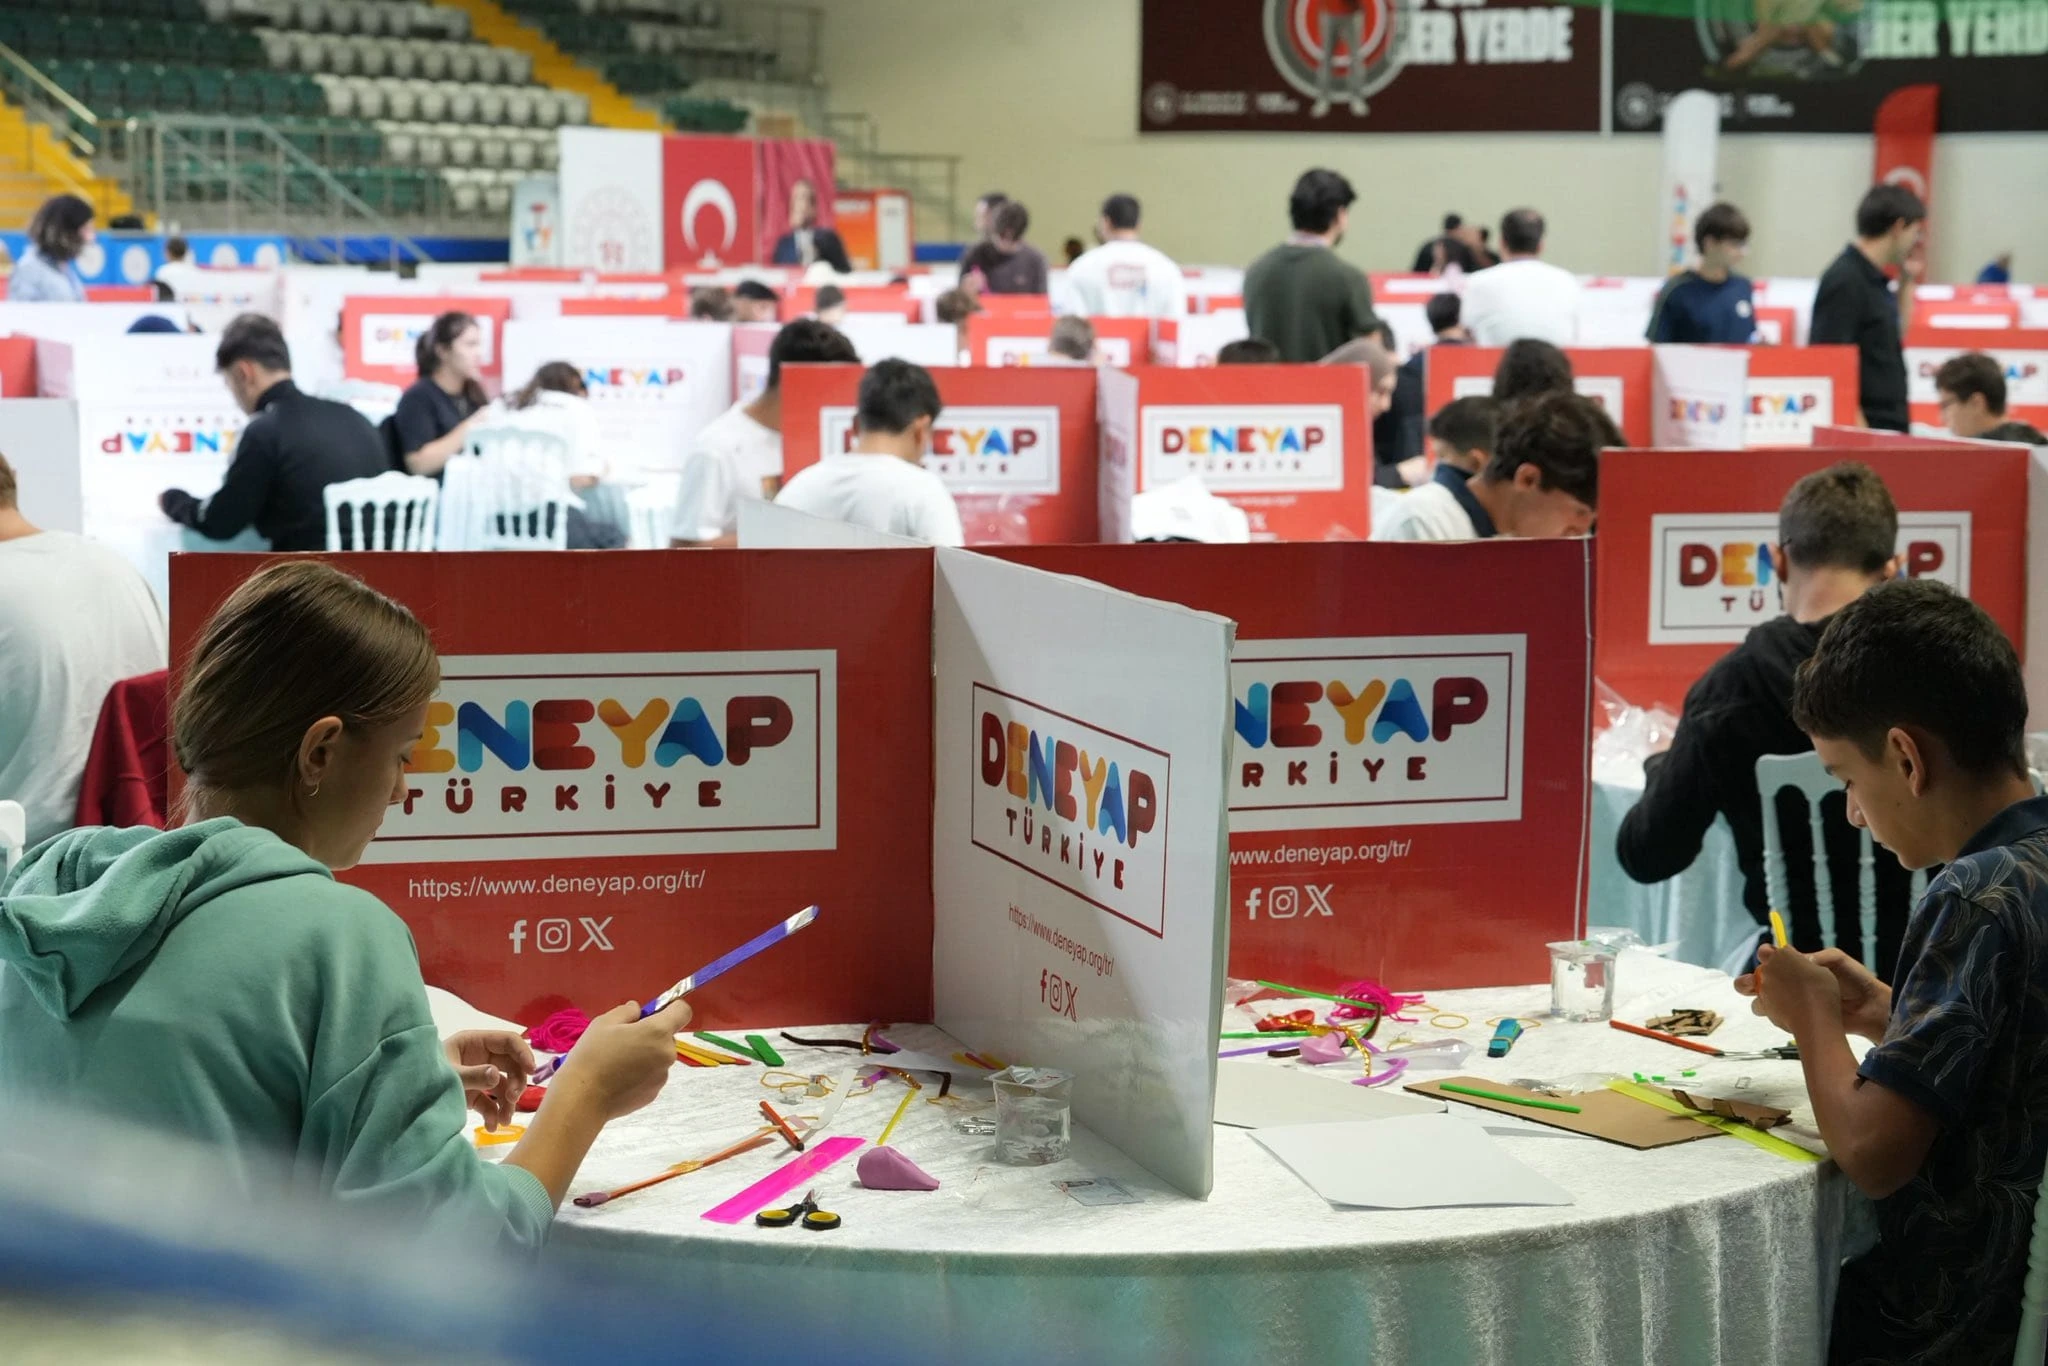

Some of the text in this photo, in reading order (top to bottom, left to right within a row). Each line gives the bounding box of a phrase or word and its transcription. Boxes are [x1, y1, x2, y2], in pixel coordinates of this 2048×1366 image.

[1459, 6, 1574, 64] YERDE
[586, 367, 684, 386] NEYAP
[102, 431, 239, 453] ENEYAP
[1162, 426, 1324, 454] DENEYAP
[1235, 677, 1489, 749] NEYAP
[403, 695, 793, 774] ENEYAP
[981, 711, 1157, 849] DENEYAP
[1241, 751, 1427, 788] RKİYE
[403, 774, 722, 816] TÜRKİYE
[1006, 807, 1125, 890] TÜRKİYE
[1229, 839, 1412, 866] www.deneyap.org/tr/
[408, 869, 707, 902] https://www.deneyap.org/tr/
[1008, 902, 1115, 978] https://www.deneyap.org/tr/
